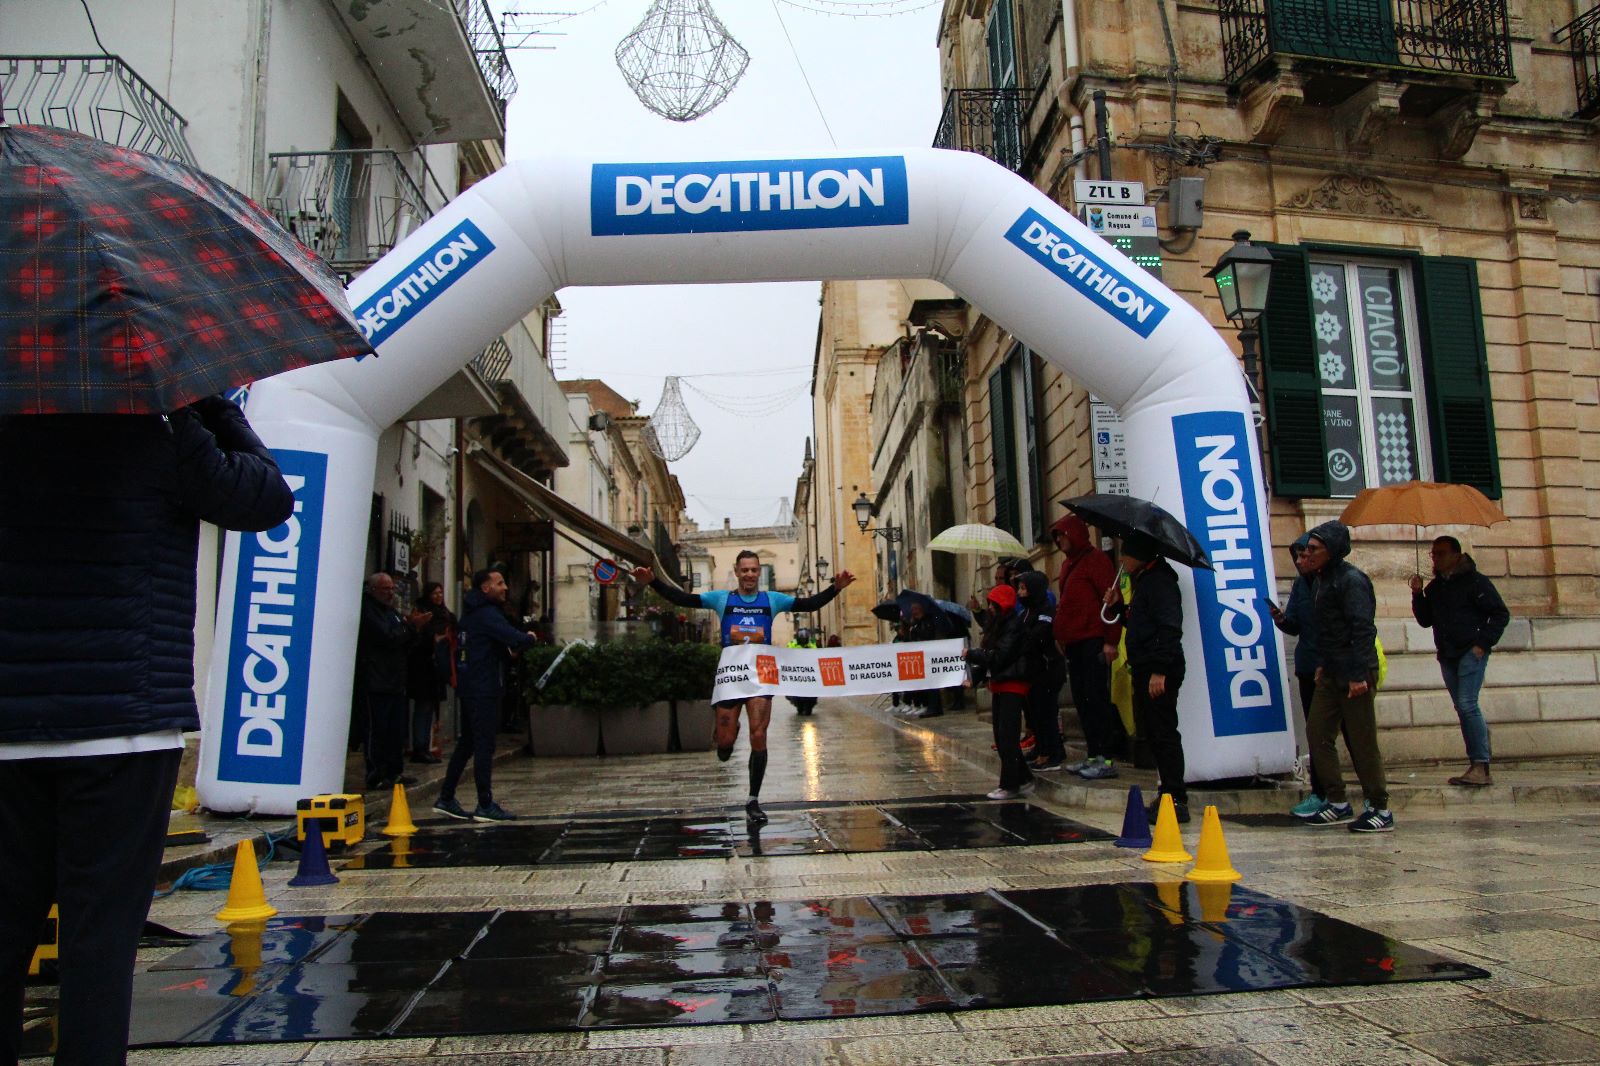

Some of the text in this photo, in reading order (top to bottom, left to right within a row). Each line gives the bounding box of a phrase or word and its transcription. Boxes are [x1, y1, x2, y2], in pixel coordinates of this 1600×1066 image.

[614, 167, 885, 217] DECATHLON
[1089, 185, 1130, 199] ZTL B
[1107, 212, 1139, 220] Comune di
[1108, 221, 1131, 230] Ragusa
[1020, 220, 1154, 325] DECATHLON
[1195, 434, 1272, 710] DECATHLON
[781, 665, 815, 674] MARATONA
[848, 660, 893, 672] MARATONA
[931, 666, 940, 674] DI
[717, 674, 750, 686] RAGUSA
[781, 674, 816, 683] DI RAGUSA
[850, 670, 893, 681] DI RAGUSA
